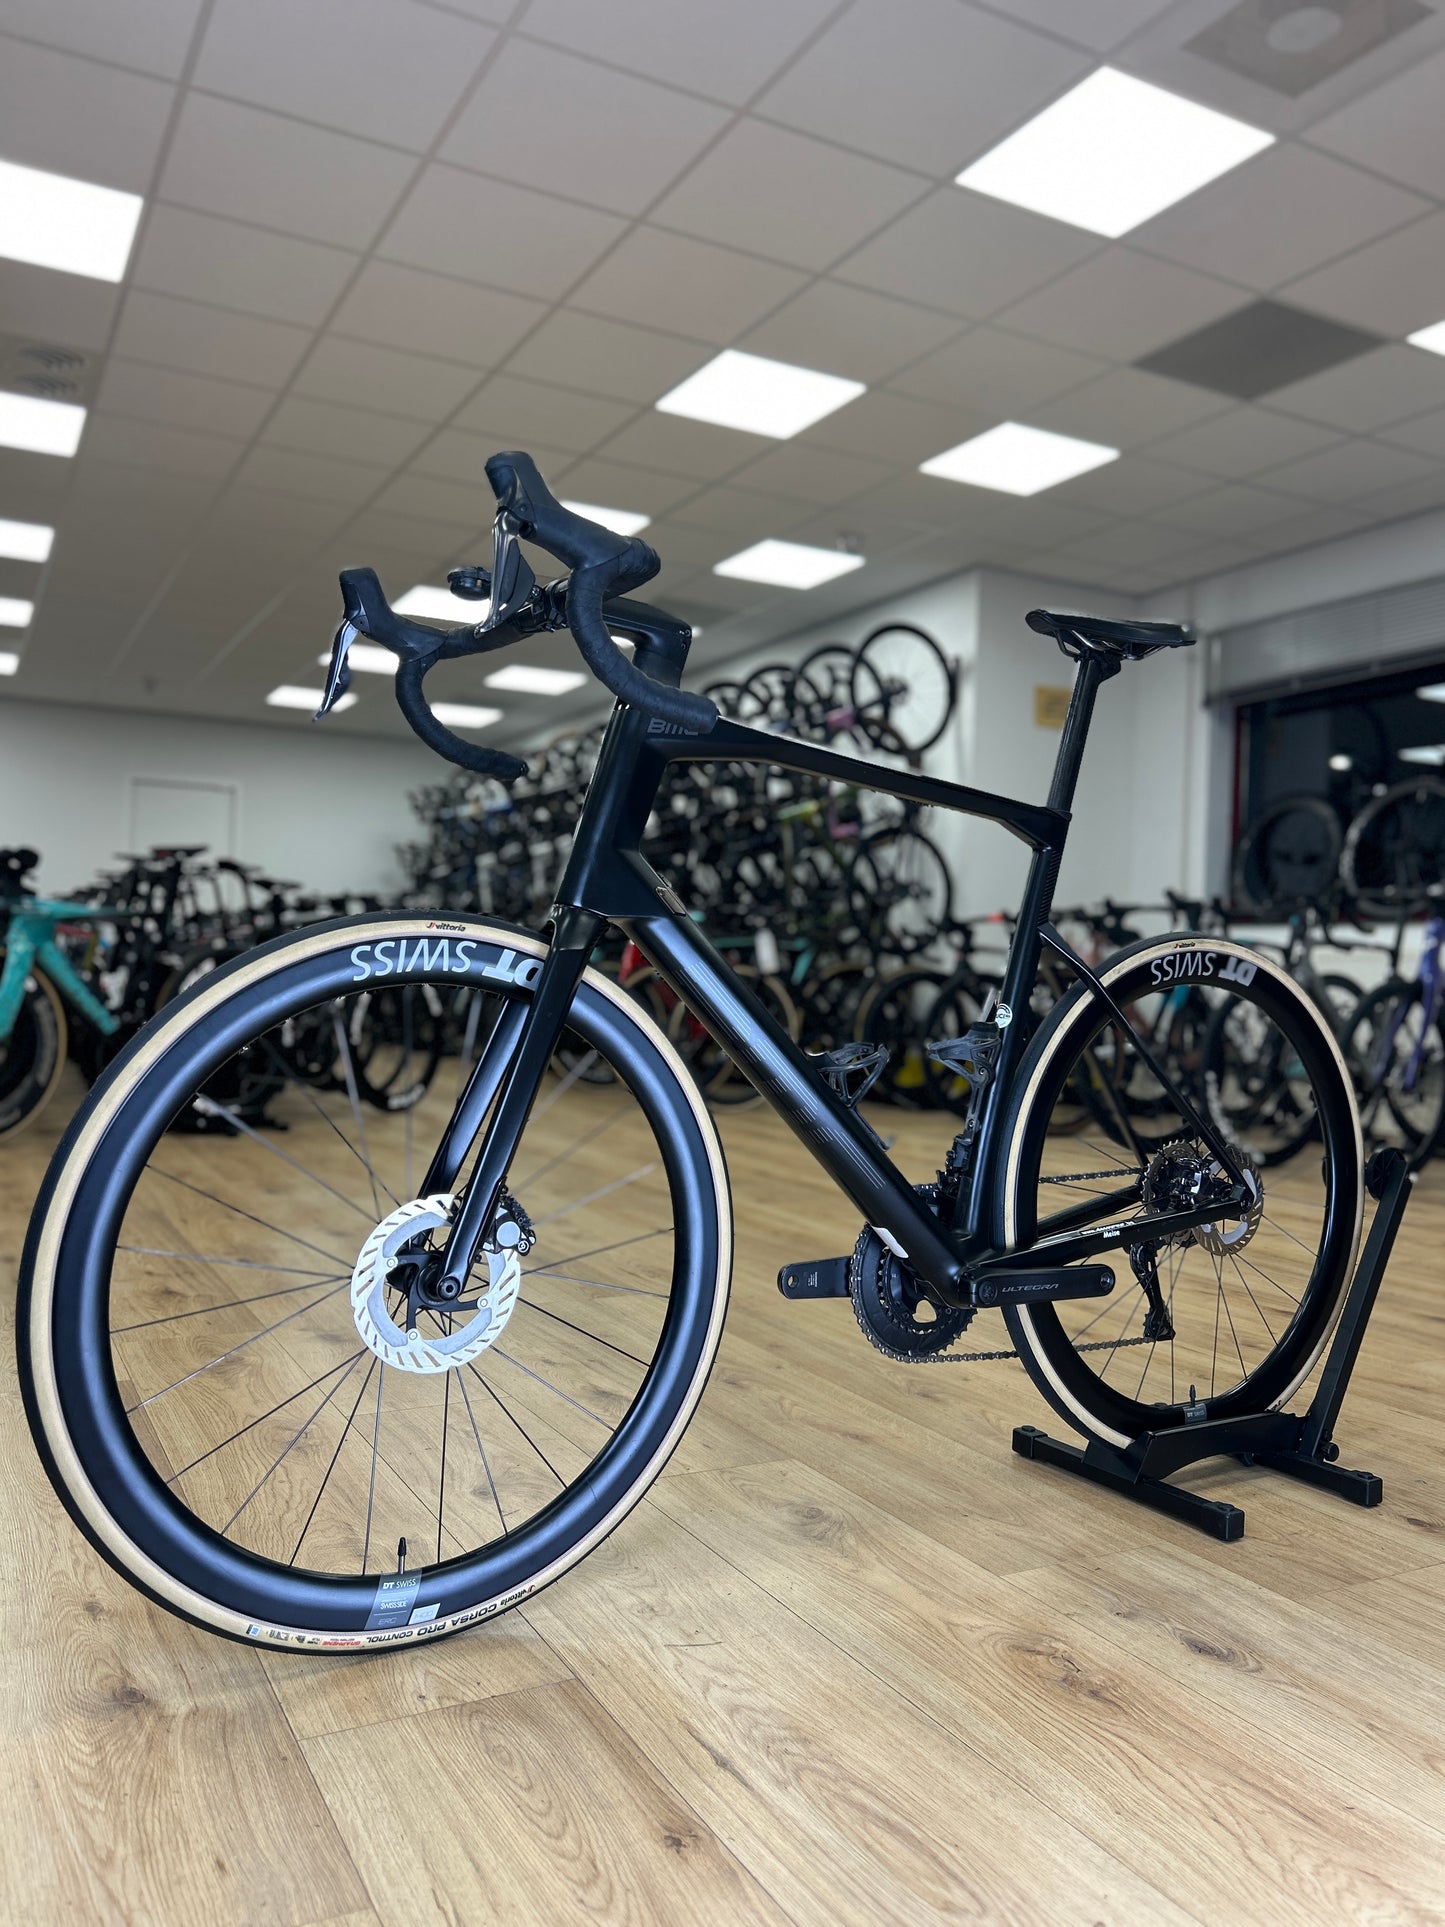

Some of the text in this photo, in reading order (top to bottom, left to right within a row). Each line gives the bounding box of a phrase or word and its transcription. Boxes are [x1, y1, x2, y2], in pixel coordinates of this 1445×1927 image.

[433, 922, 466, 932] vittoria
[350, 938, 545, 992] DT SWISS
[1150, 952, 1258, 987] DT SWISS
[1002, 1284, 1059, 1293] ULTEGRA
[382, 1578, 417, 1590] DT SWISS
[451, 1603, 498, 1627] CORSA
[417, 1621, 447, 1637] PRO
[366, 1630, 413, 1644] CONTROL
